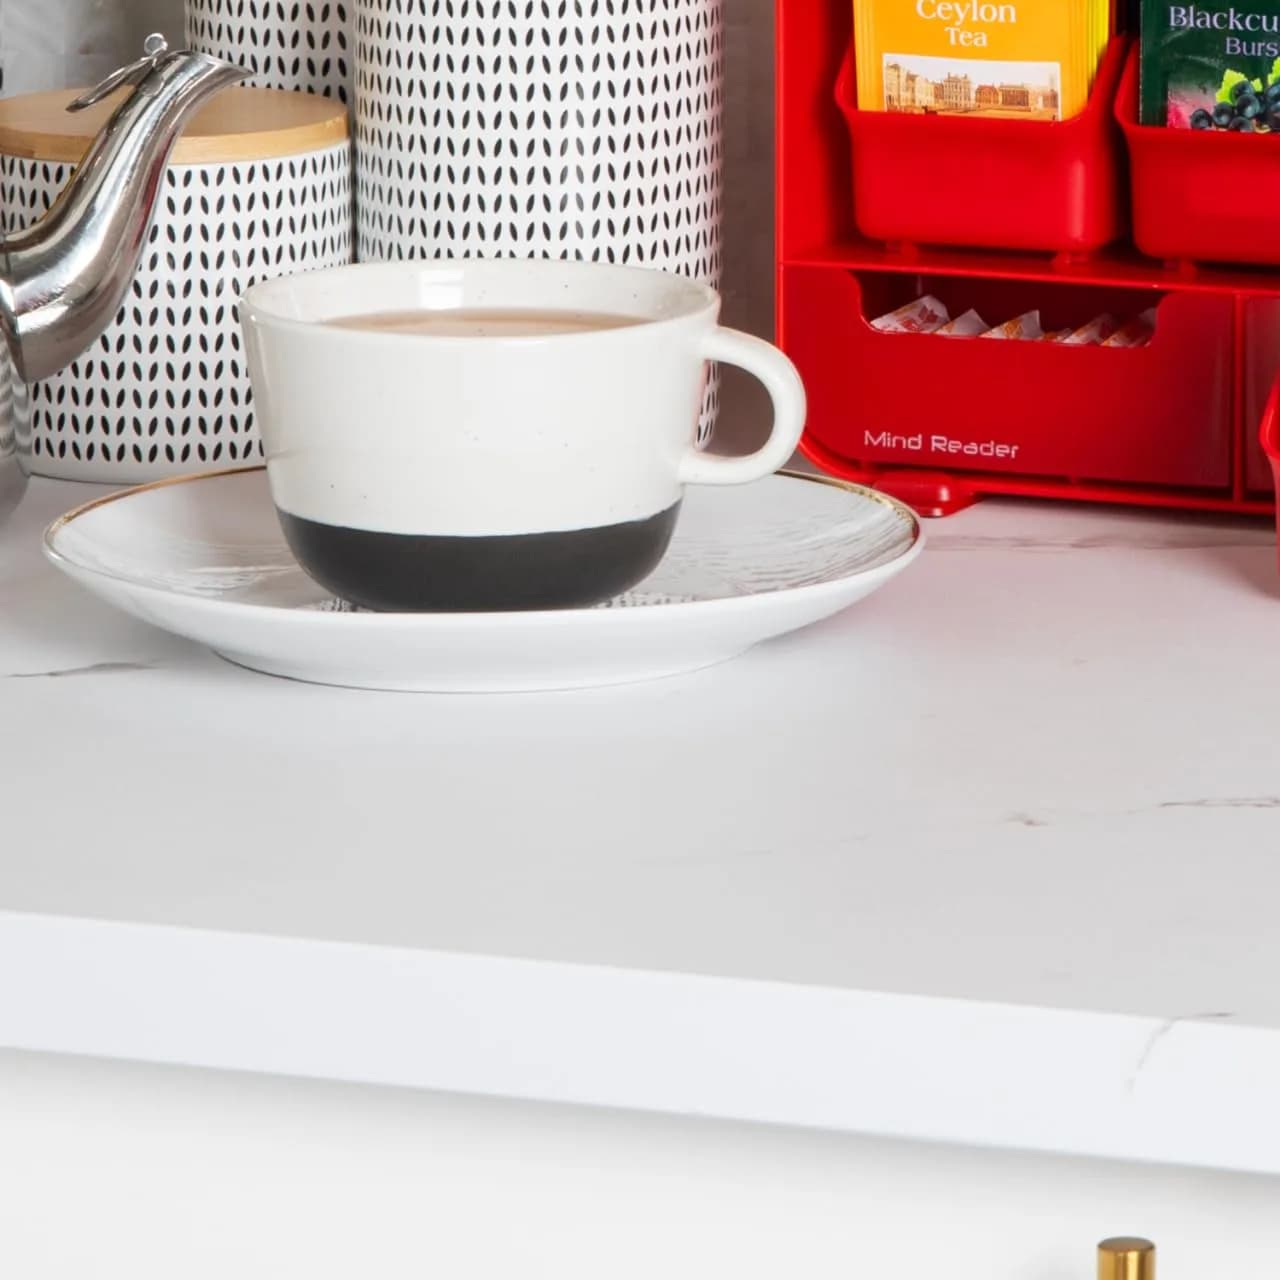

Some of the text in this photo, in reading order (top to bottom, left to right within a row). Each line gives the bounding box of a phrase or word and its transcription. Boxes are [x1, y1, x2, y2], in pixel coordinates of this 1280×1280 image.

[944, 26, 988, 48] Tea
[864, 430, 1019, 459] Mind Reader
